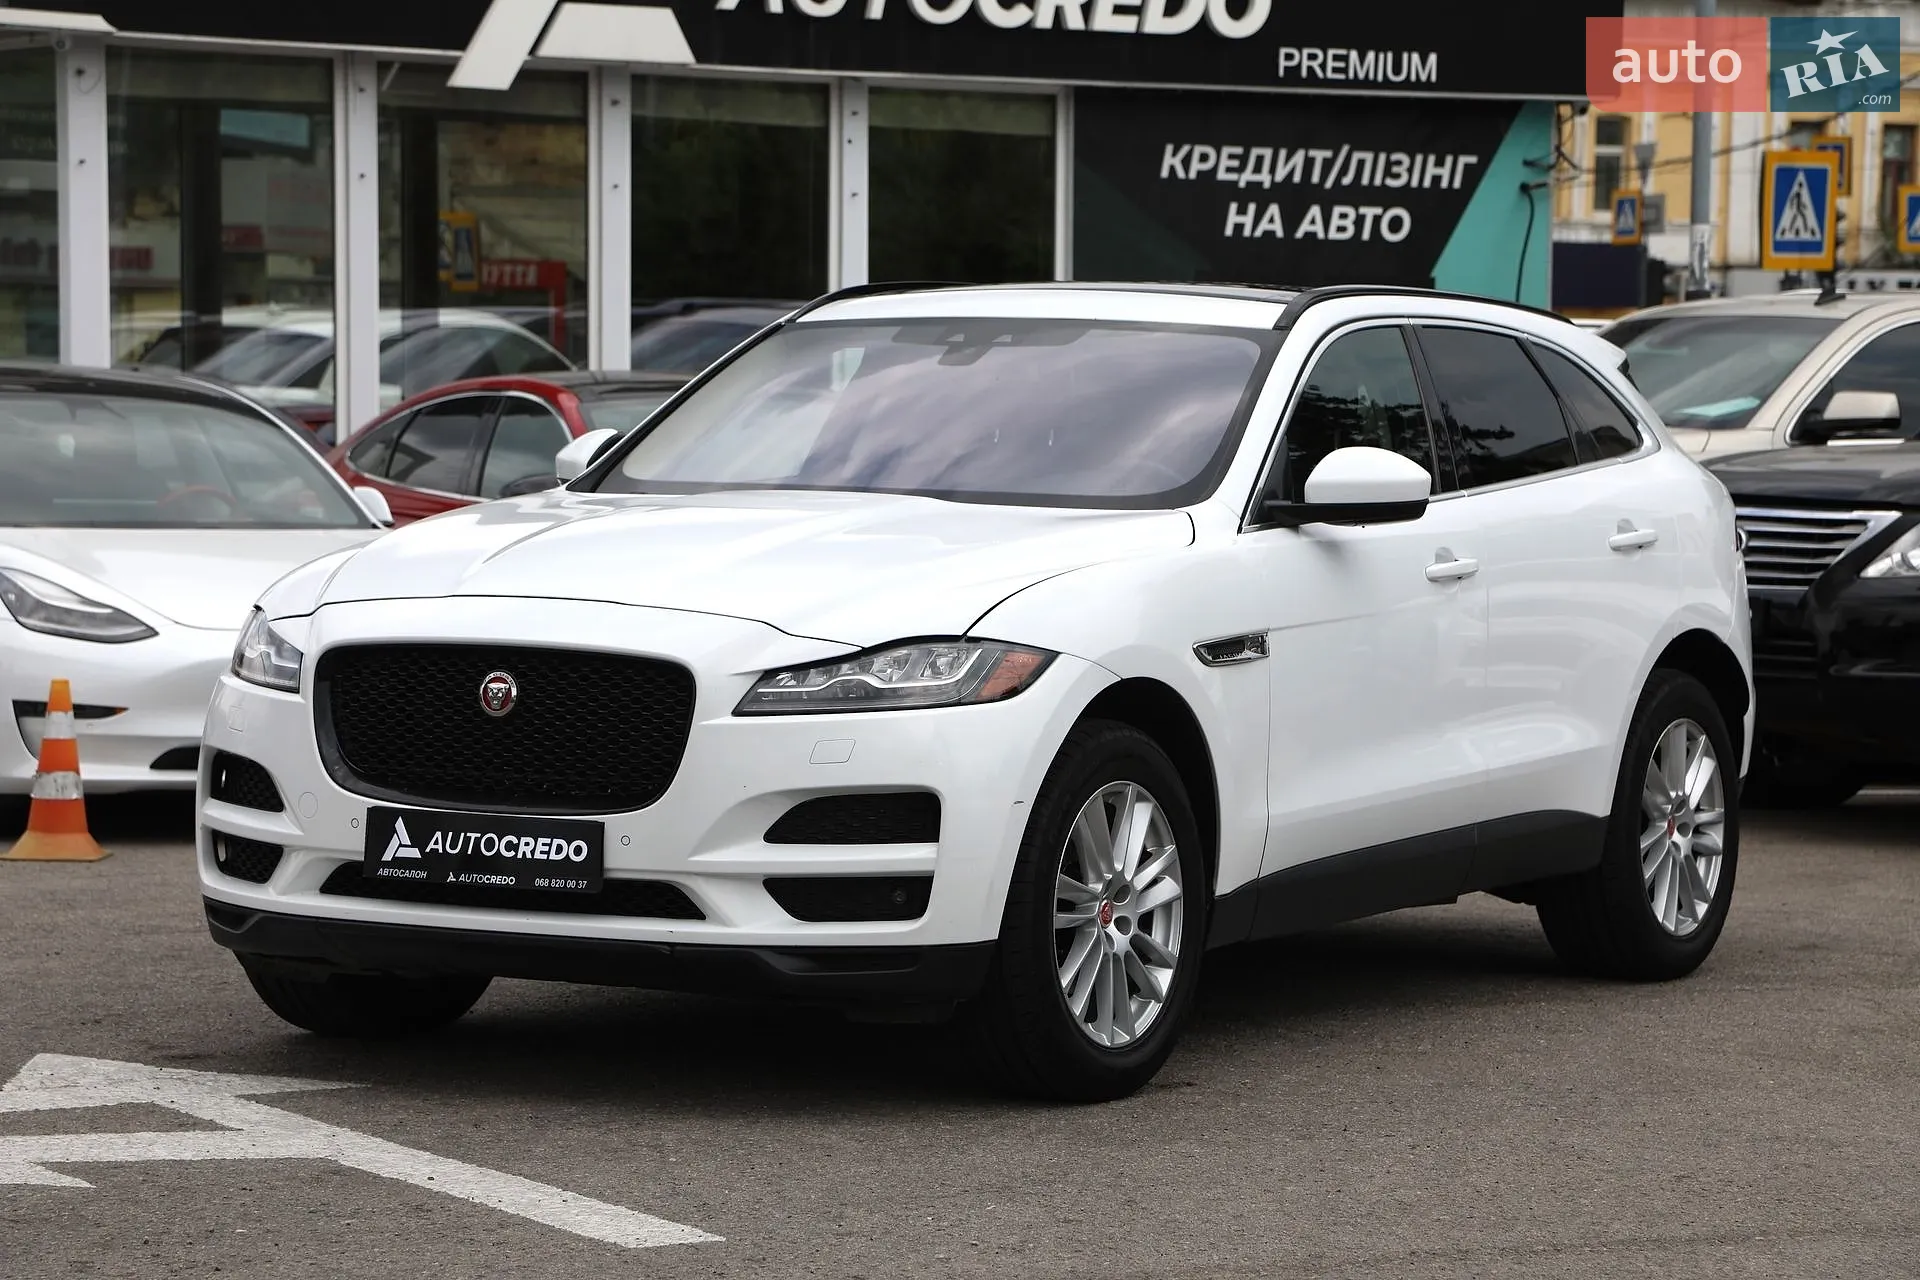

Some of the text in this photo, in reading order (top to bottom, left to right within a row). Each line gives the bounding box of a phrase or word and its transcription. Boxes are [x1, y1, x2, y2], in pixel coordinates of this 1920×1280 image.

[715, 0, 1272, 39] CREDO
[1278, 47, 1438, 83] PREMIUM
[1160, 143, 1478, 190] КРЕДИТ/ЛІЗІНГ
[1223, 201, 1412, 243] НА АВТО
[425, 830, 588, 863] AUTOCREDO
[377, 867, 428, 879] АВТОСАЛОН
[458, 873, 516, 885] AUTOCREDO
[534, 877, 588, 889] 068 820 00 37
